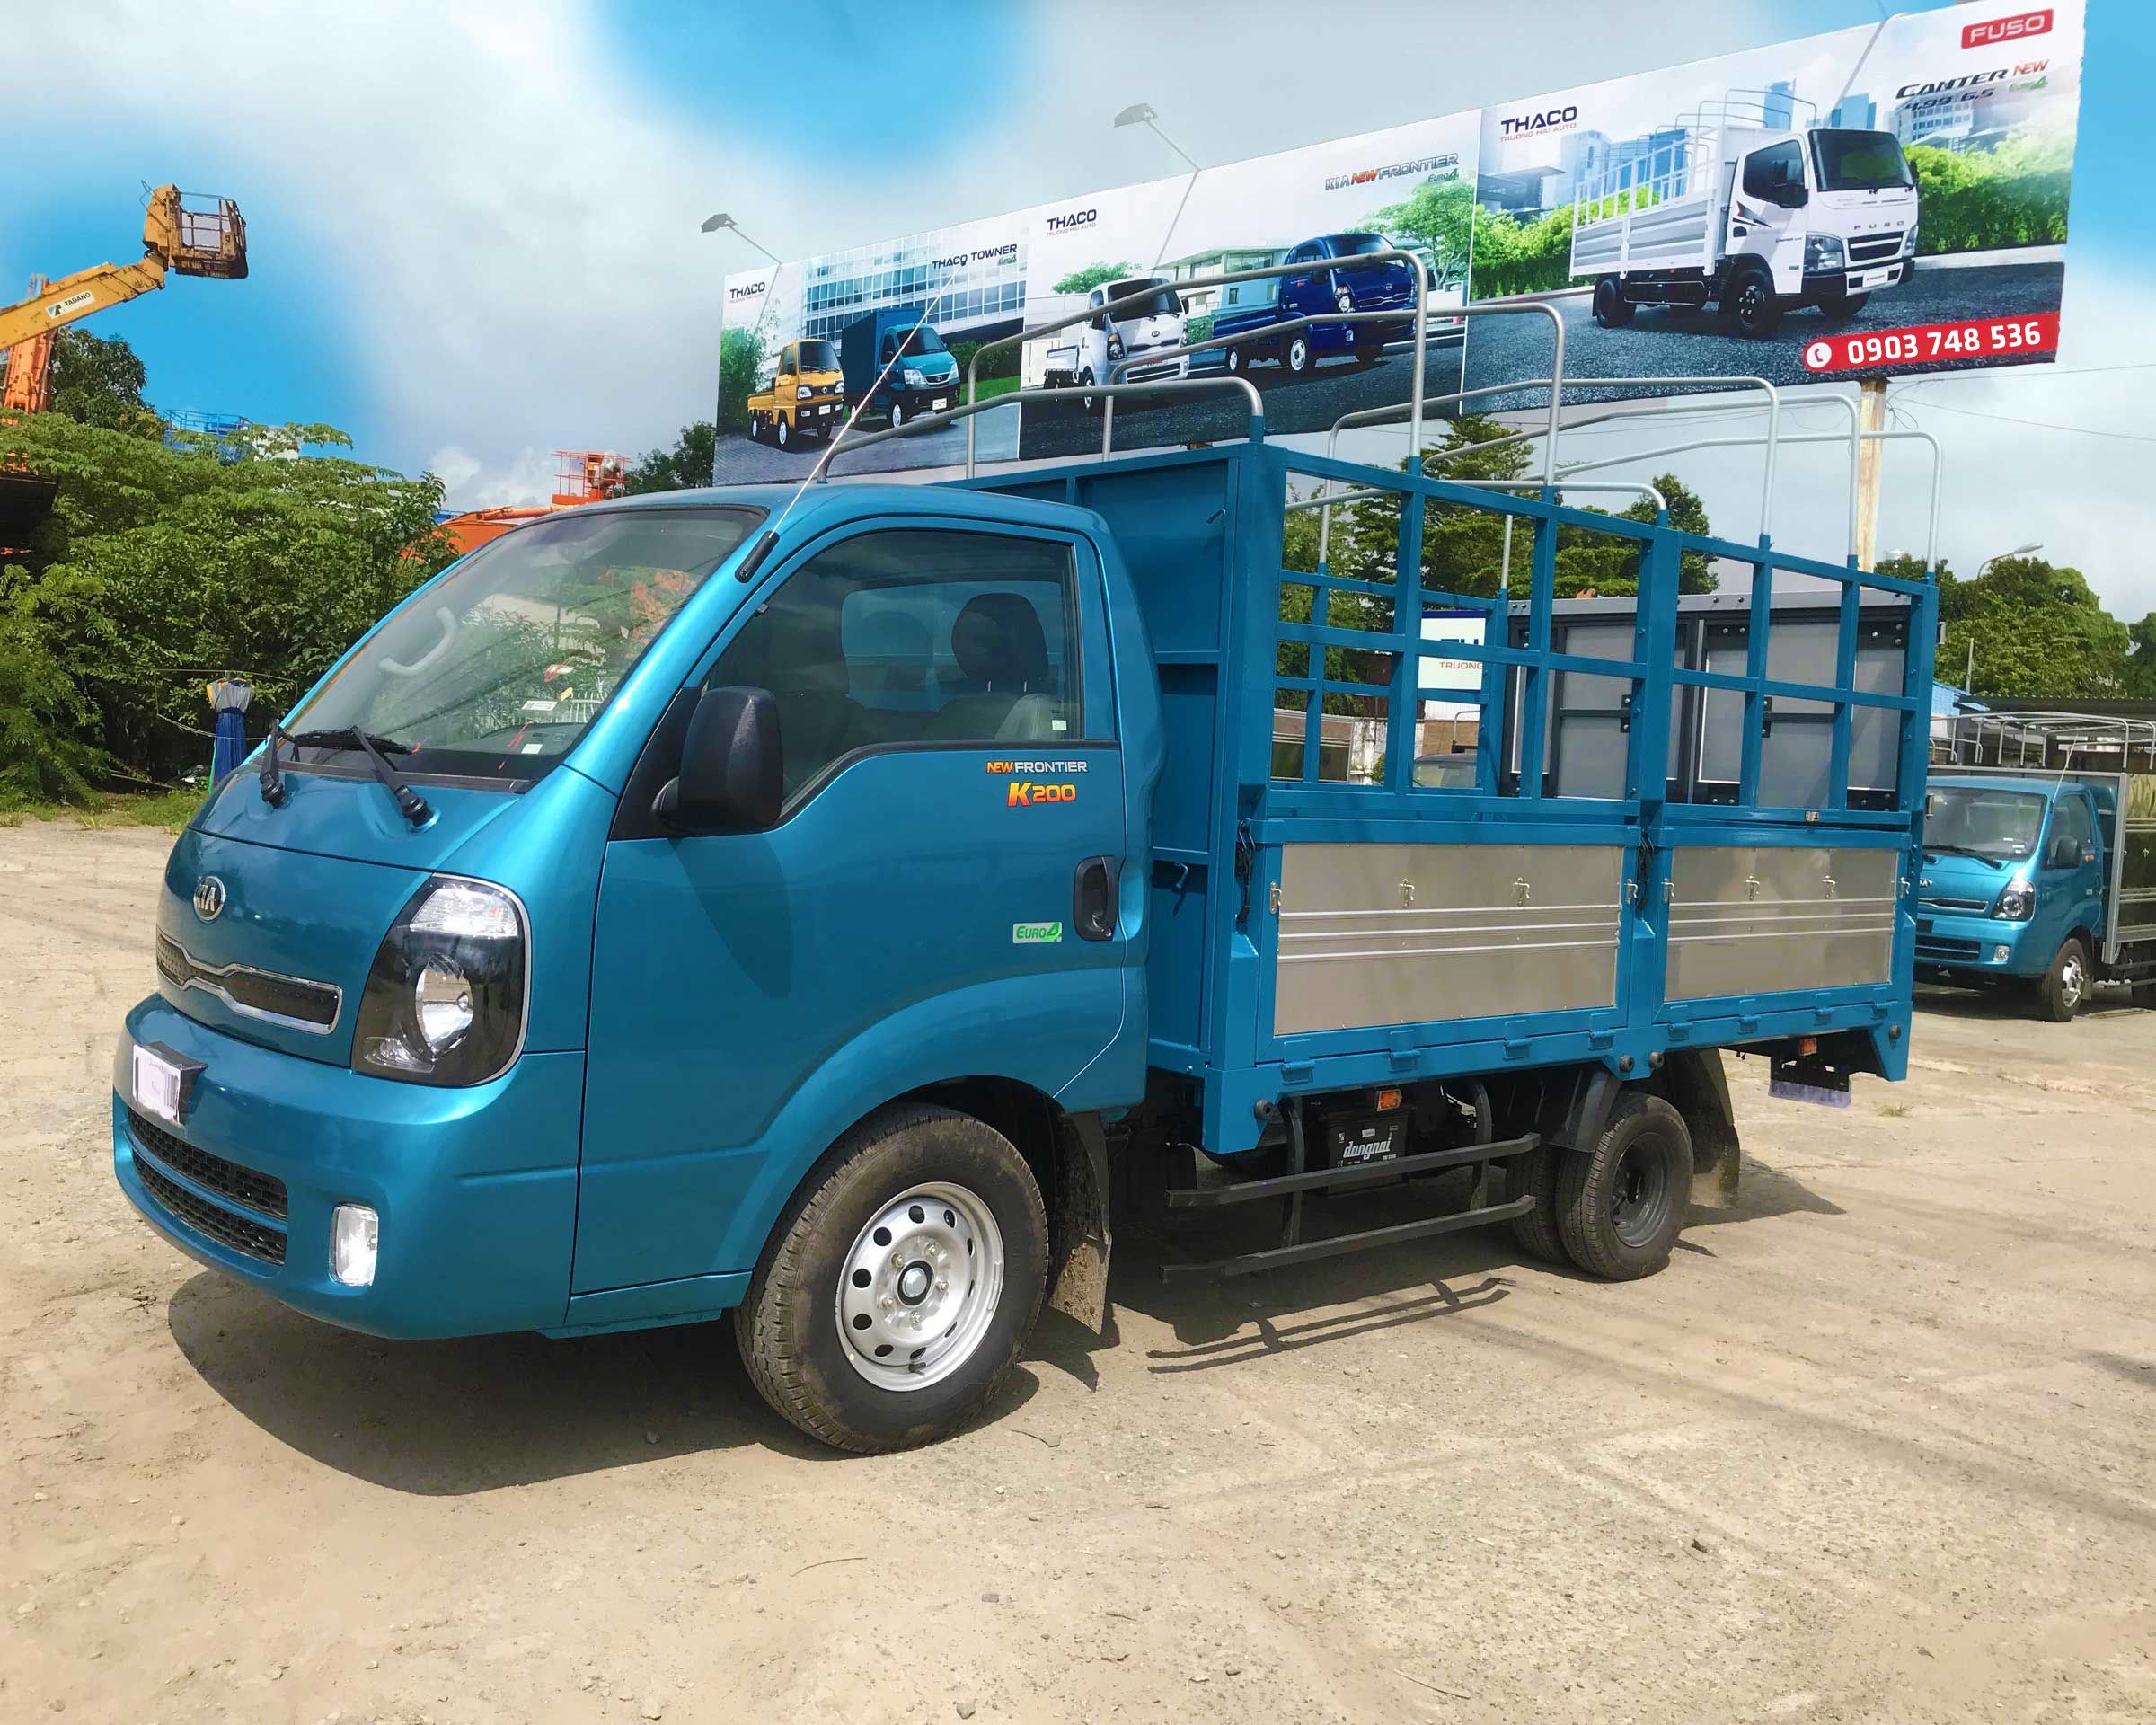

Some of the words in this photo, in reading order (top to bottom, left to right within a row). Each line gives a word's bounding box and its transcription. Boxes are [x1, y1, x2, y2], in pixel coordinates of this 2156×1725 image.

[1970, 14, 2045, 44] FUSO
[1895, 68, 2009, 99] CANTER
[2012, 58, 2049, 76] NEW
[1905, 96, 1952, 111] 4.99
[1960, 87, 1996, 102] 6.5
[1500, 106, 1577, 135] THACO
[1501, 131, 1534, 142] TRUONG
[1553, 123, 1577, 132] AUTO
[1325, 175, 1350, 190] KIA
[1047, 208, 1097, 231] THACO
[932, 254, 968, 270] THACO
[971, 243, 1017, 261] TOWNER
[729, 281, 765, 299] THACO
[1847, 334, 1919, 364] 0903
[1926, 328, 1980, 355] 748
[1990, 321, 2041, 349] 536
[1007, 782, 1077, 807] K200
[196, 883, 216, 912] KIA
